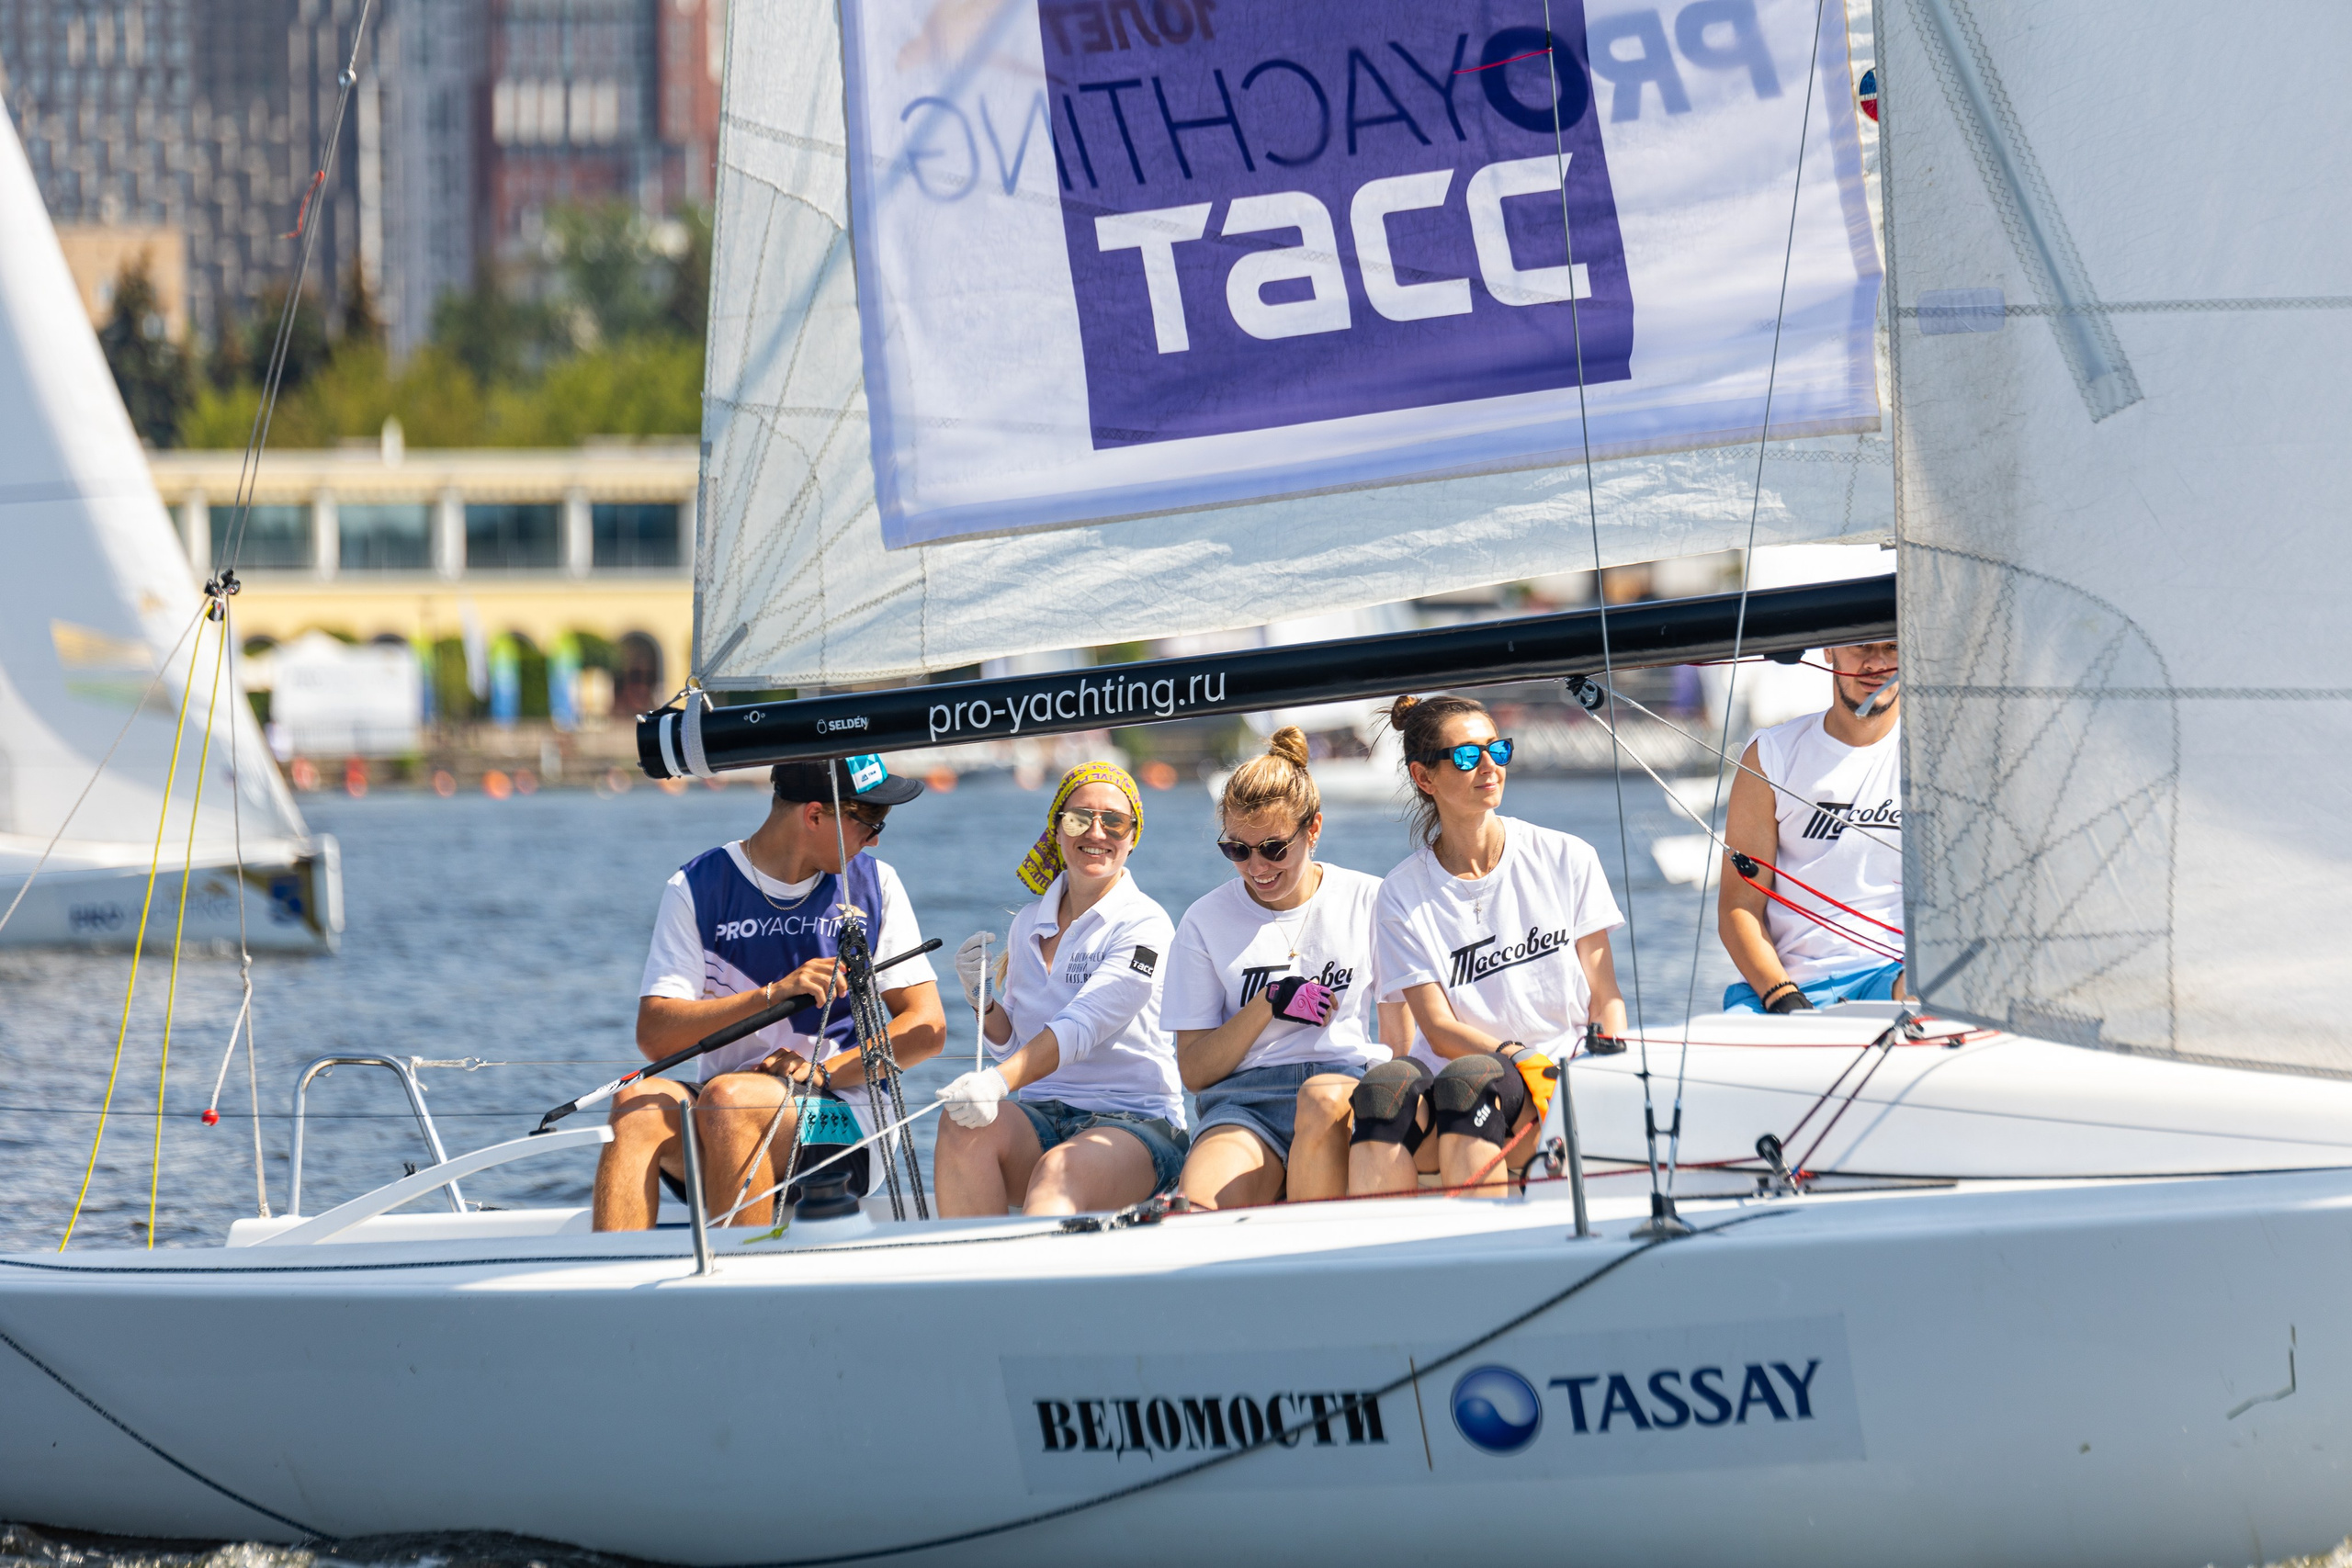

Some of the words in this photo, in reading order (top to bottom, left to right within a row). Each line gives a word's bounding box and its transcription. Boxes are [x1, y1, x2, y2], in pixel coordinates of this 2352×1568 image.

[828, 716, 869, 732] SELDÉN
[928, 671, 1227, 742] pro-yachting.ru
[1449, 926, 1570, 988] Тассовец
[1473, 1103, 1492, 1128] Gill
[1032, 1391, 1389, 1463] ВЕДОМОСТИ
[1547, 1358, 1823, 1435] TASSAY
